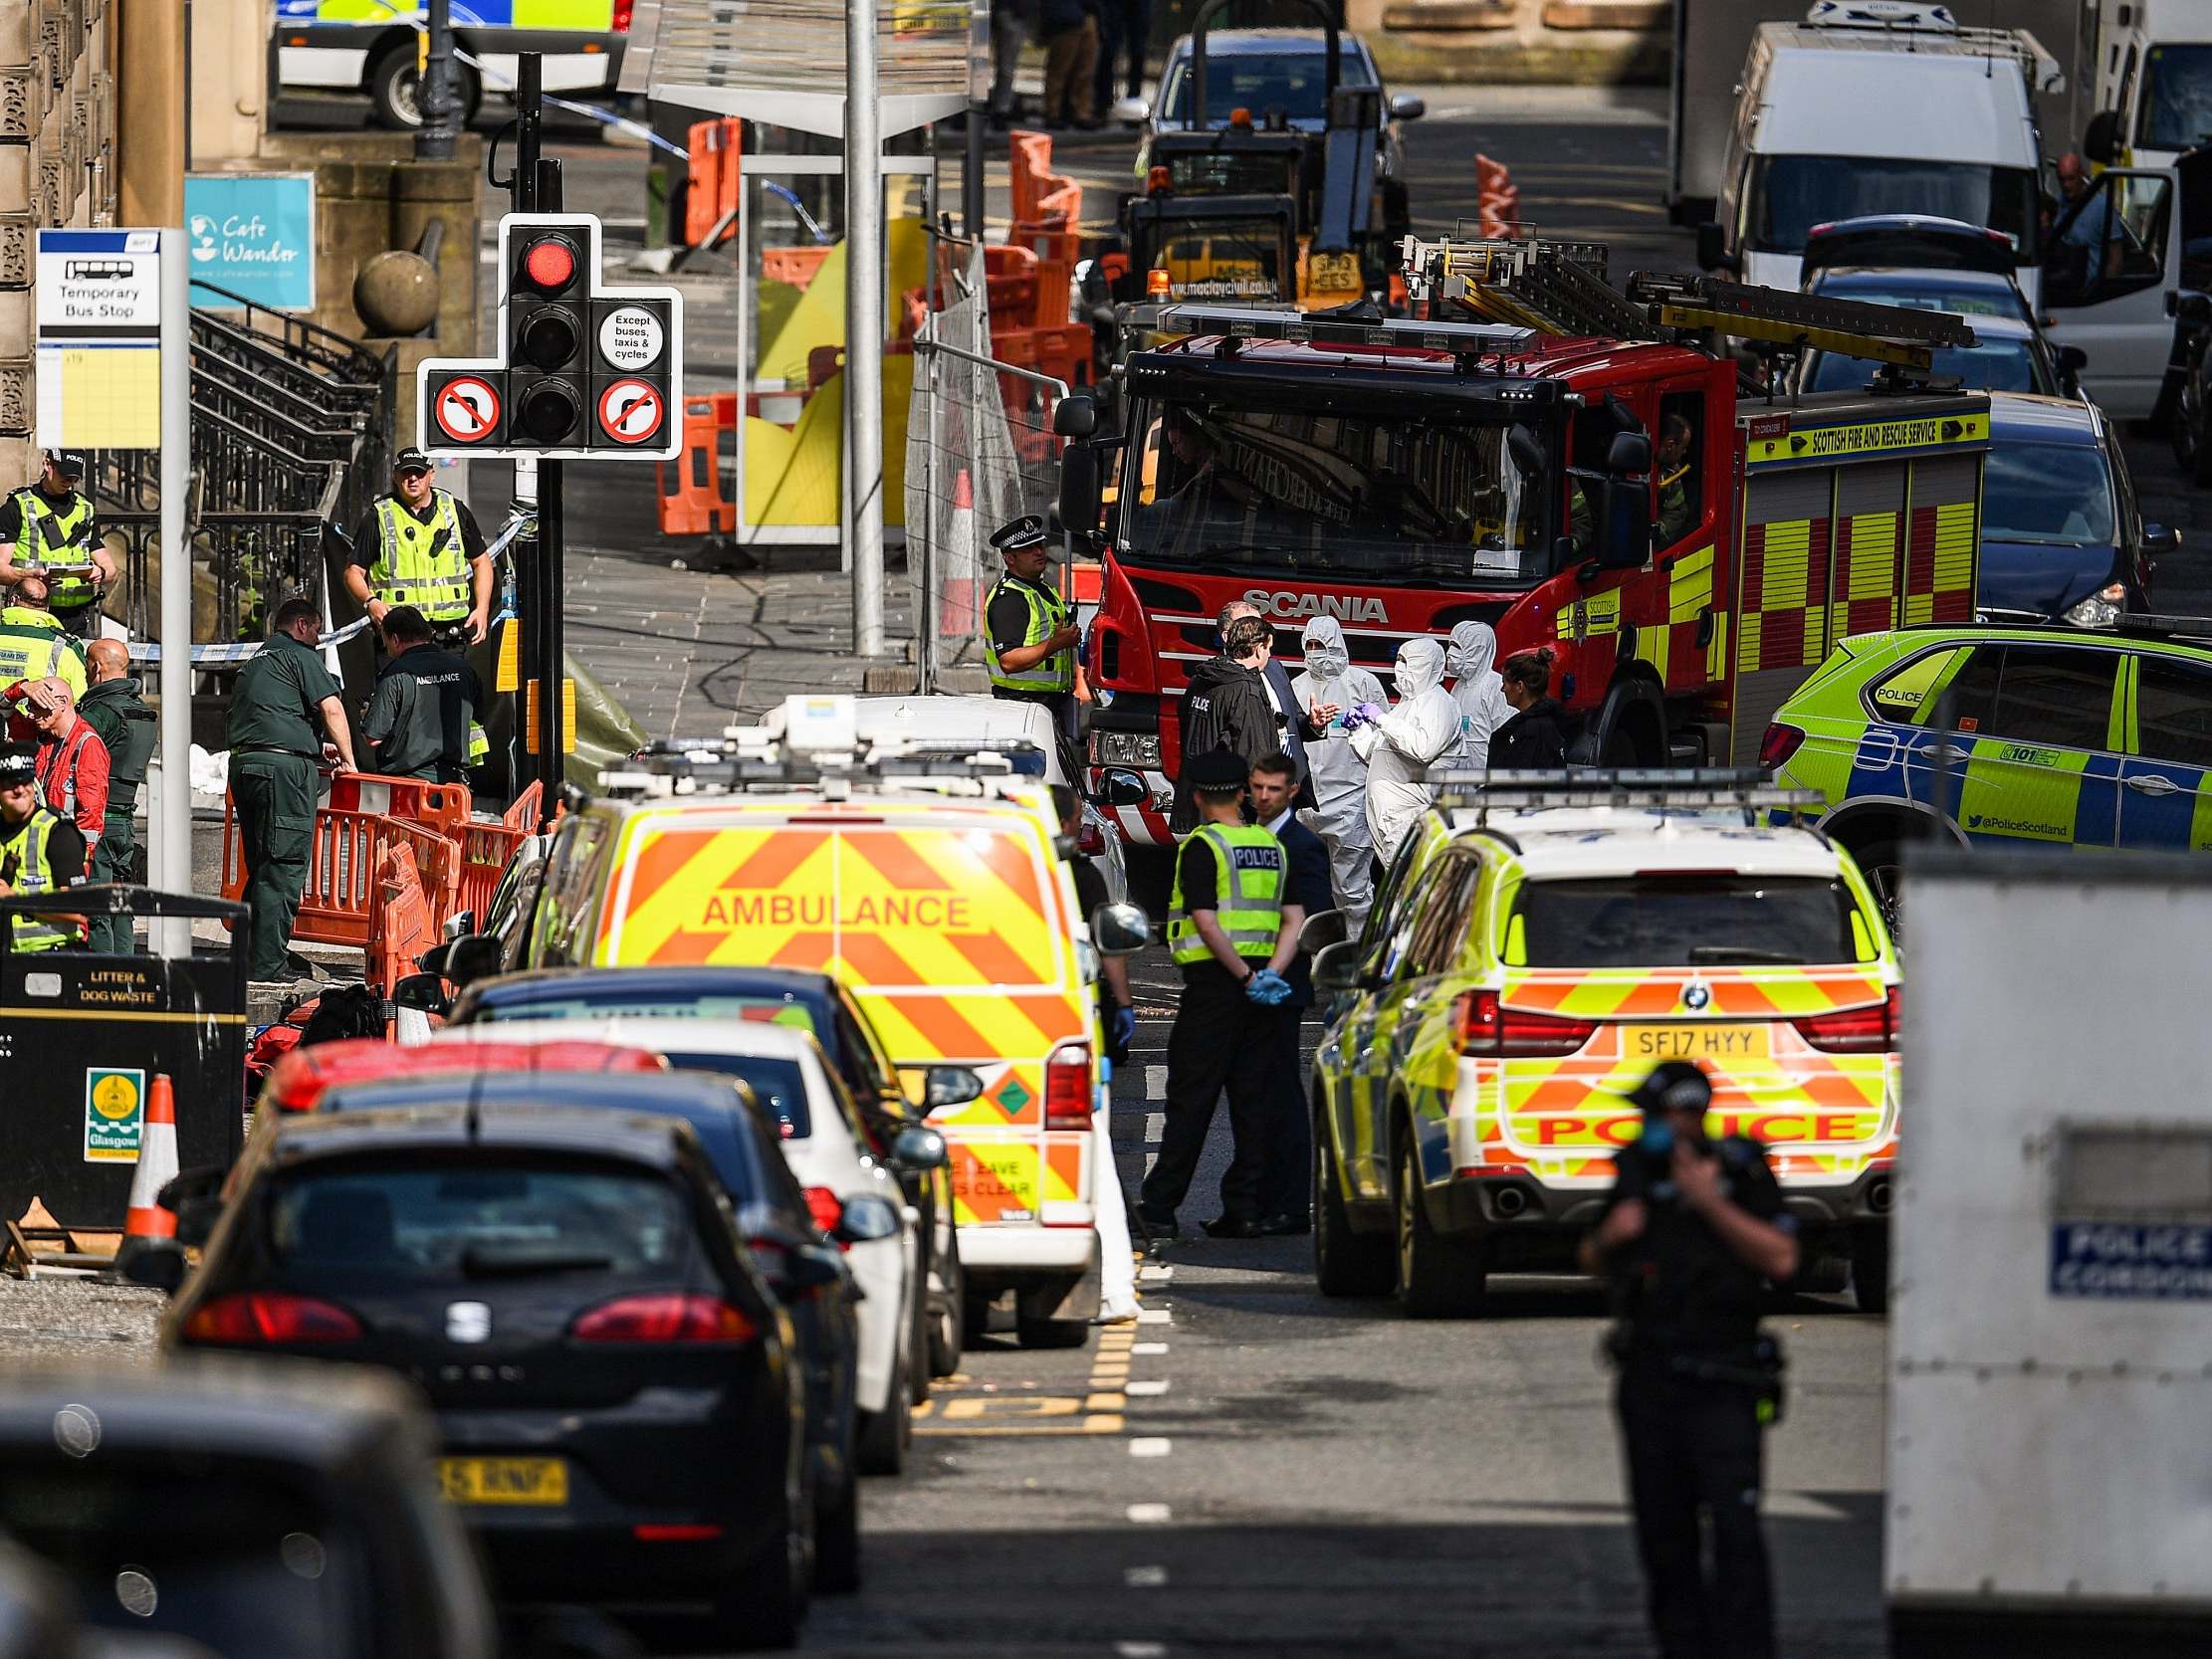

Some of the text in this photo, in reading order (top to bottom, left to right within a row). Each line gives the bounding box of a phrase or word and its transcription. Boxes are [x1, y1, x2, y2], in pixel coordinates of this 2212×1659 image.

[222, 214, 267, 240] Cafe
[222, 240, 299, 263] Wander
[60, 286, 139, 301] Temporary
[66, 305, 134, 318] Bus Stop
[615, 314, 650, 326] Except
[615, 326, 649, 337] buses,
[614, 338, 639, 347] taxis
[614, 349, 648, 360] cycles
[1813, 421, 1936, 453] SCOTTISH FIRE AND RESCUE SERVICE
[1243, 589, 1389, 624] SCANIA
[1590, 599, 1615, 614] SCOTTISH
[416, 673, 461, 685] AMBULANCE
[1877, 689, 1922, 703] POLICE
[2011, 747, 2038, 762] 101
[1982, 816, 2067, 837] @PoliceScotland
[1235, 849, 1278, 866] POLICE
[702, 895, 971, 928] AMBULANCE
[91, 971, 145, 983] LITTER &
[81, 990, 156, 1003] DOG WASTE
[1639, 1030, 1753, 1055] SF17 HYY
[1538, 1114, 1857, 1145] POICE
[90, 1134, 137, 1148] Glasgow
